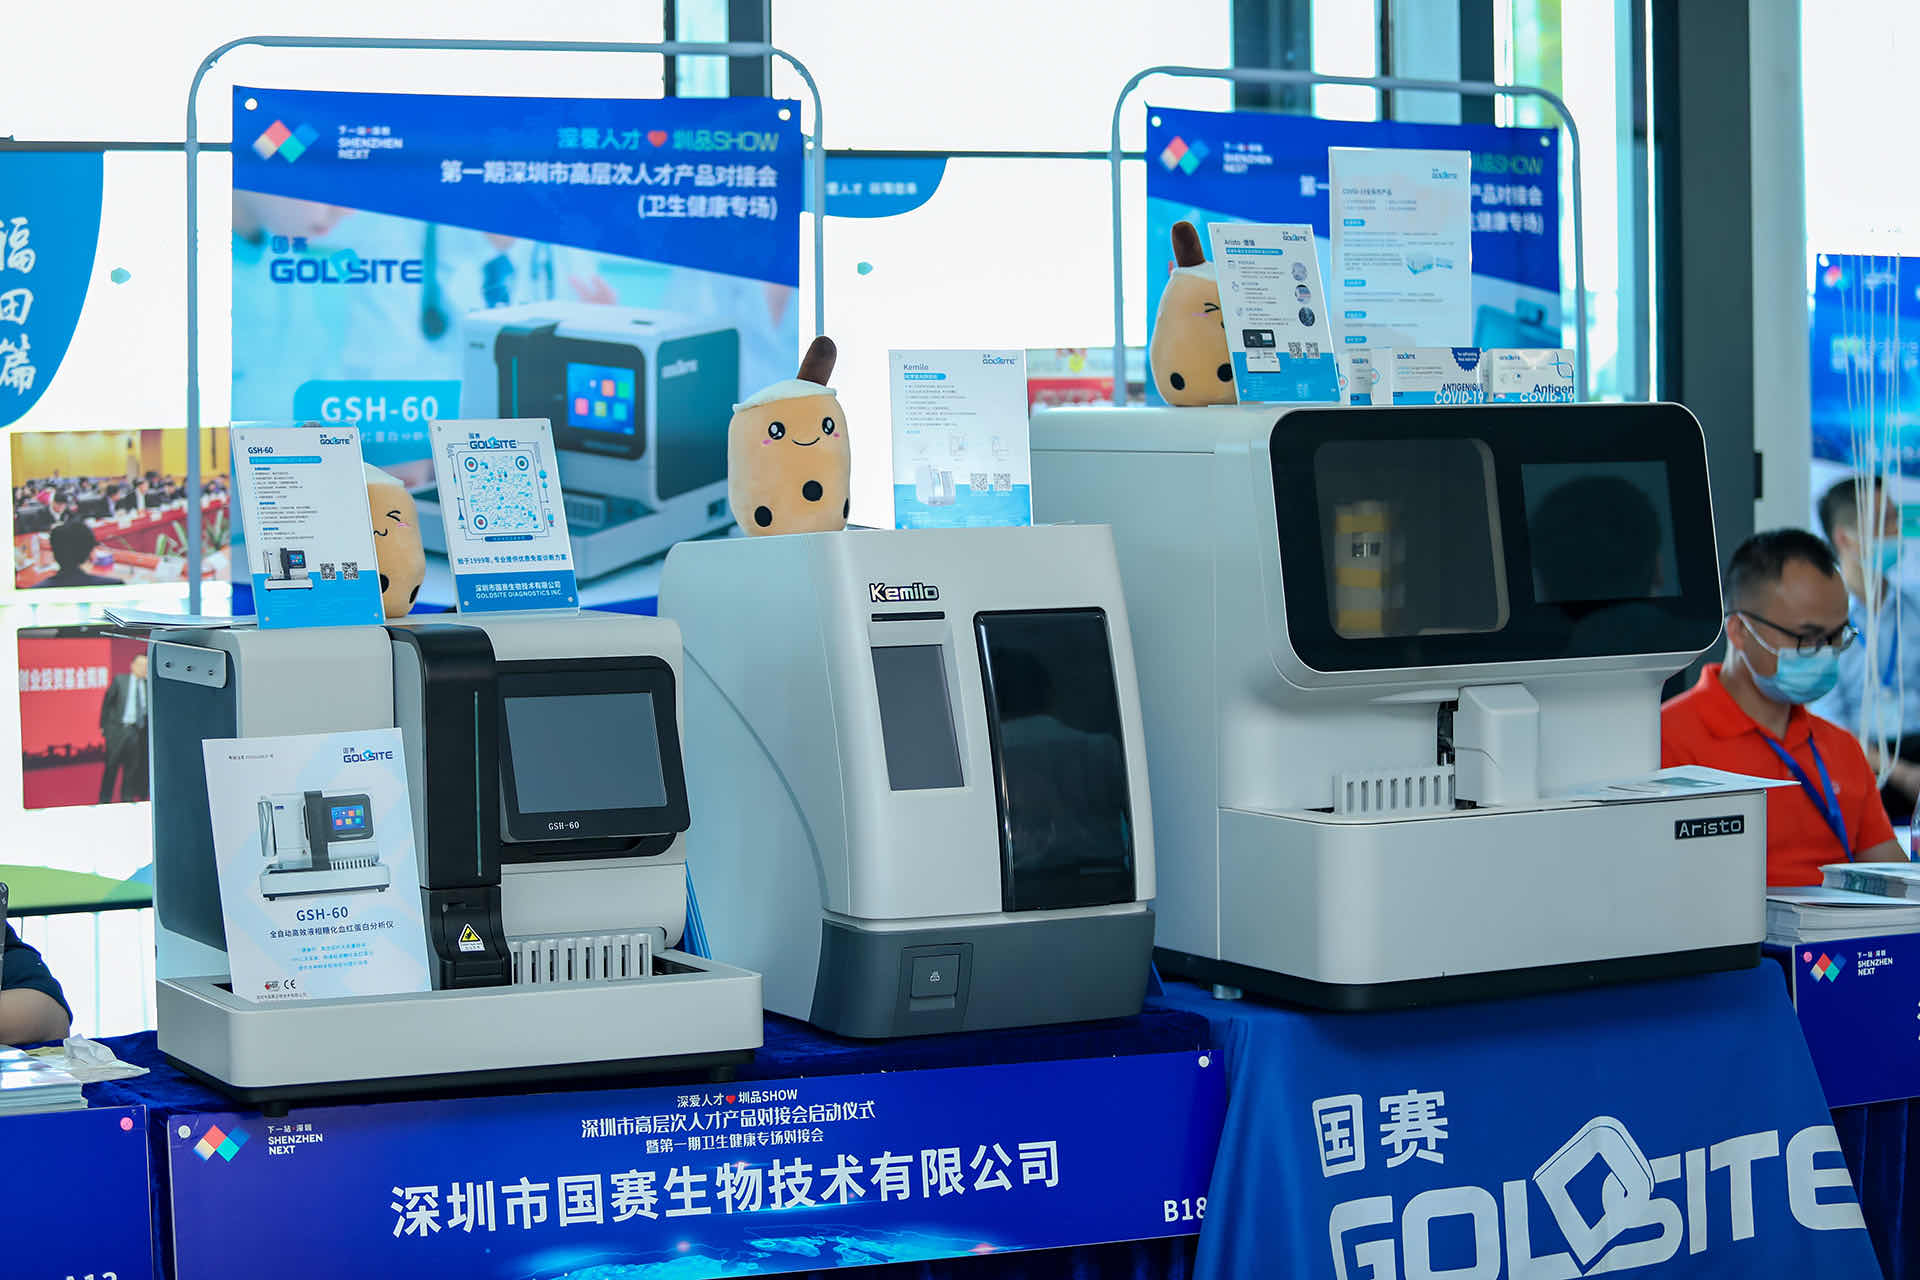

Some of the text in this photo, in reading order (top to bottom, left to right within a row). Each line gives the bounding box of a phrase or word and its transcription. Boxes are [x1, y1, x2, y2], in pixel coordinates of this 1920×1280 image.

[441, 160, 777, 187] 第一期深圳市高层次人才产品对接会
[1519, 392, 1575, 403] COVID-19
[1533, 383, 1575, 397] Antigen
[1433, 391, 1484, 405] COVID-19
[321, 396, 439, 423] GSH-60
[248, 446, 273, 454] GSH-60
[869, 583, 939, 602] Kemilo
[548, 821, 580, 831] GSH-60
[1679, 819, 1742, 837] Aristo
[296, 906, 349, 921] GSH-60
[1857, 957, 1893, 968] SHENZHEN
[1857, 967, 1875, 976] NEXT
[677, 1089, 797, 1108] 深爱人才 圳品SHOW
[581, 1101, 876, 1138] 深圳市高层次人才产品对接会启动仪式
[268, 1133, 323, 1145] SHENZHEN
[645, 1127, 824, 1154] 暨第一期卫生健康专场对接会
[1312, 1089, 1449, 1178] 国赛
[269, 1145, 296, 1155] NEXT
[390, 1140, 1060, 1238] 深圳市国赛生物技术有限公司
